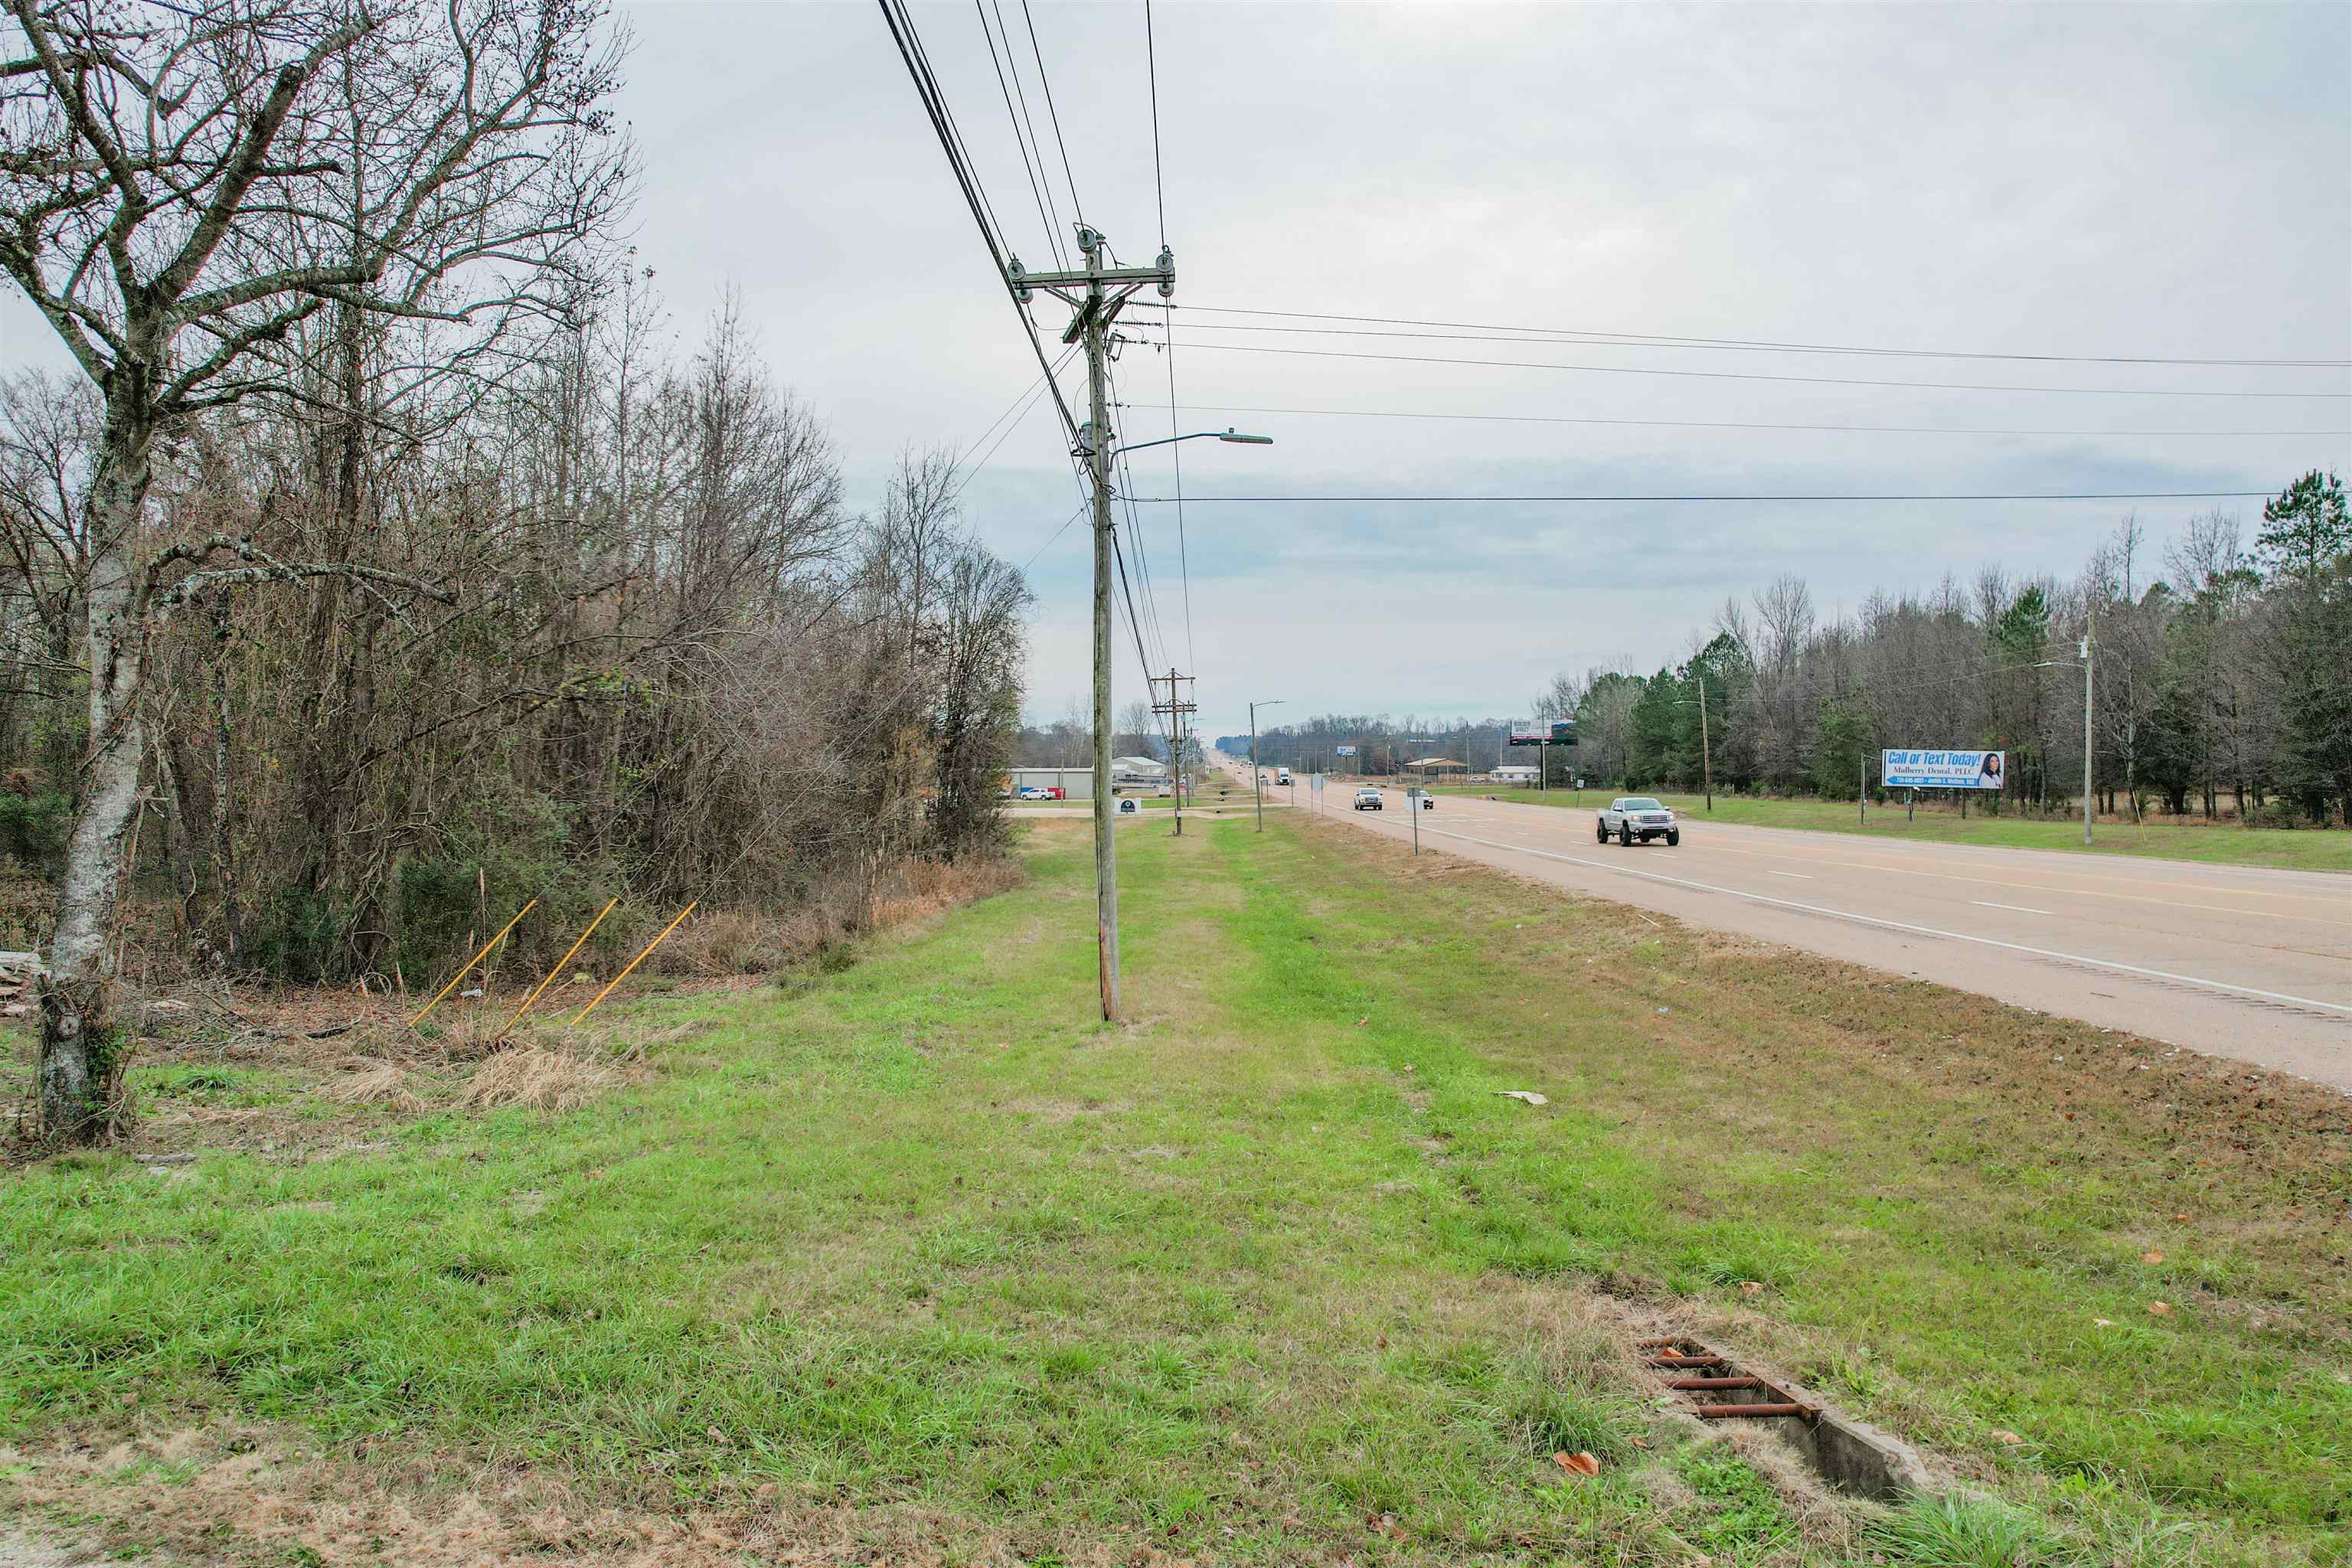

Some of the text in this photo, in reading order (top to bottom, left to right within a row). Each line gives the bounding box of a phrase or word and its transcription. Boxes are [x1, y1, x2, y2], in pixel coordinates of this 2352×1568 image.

[1888, 752, 1981, 767] Call or Text Today!
